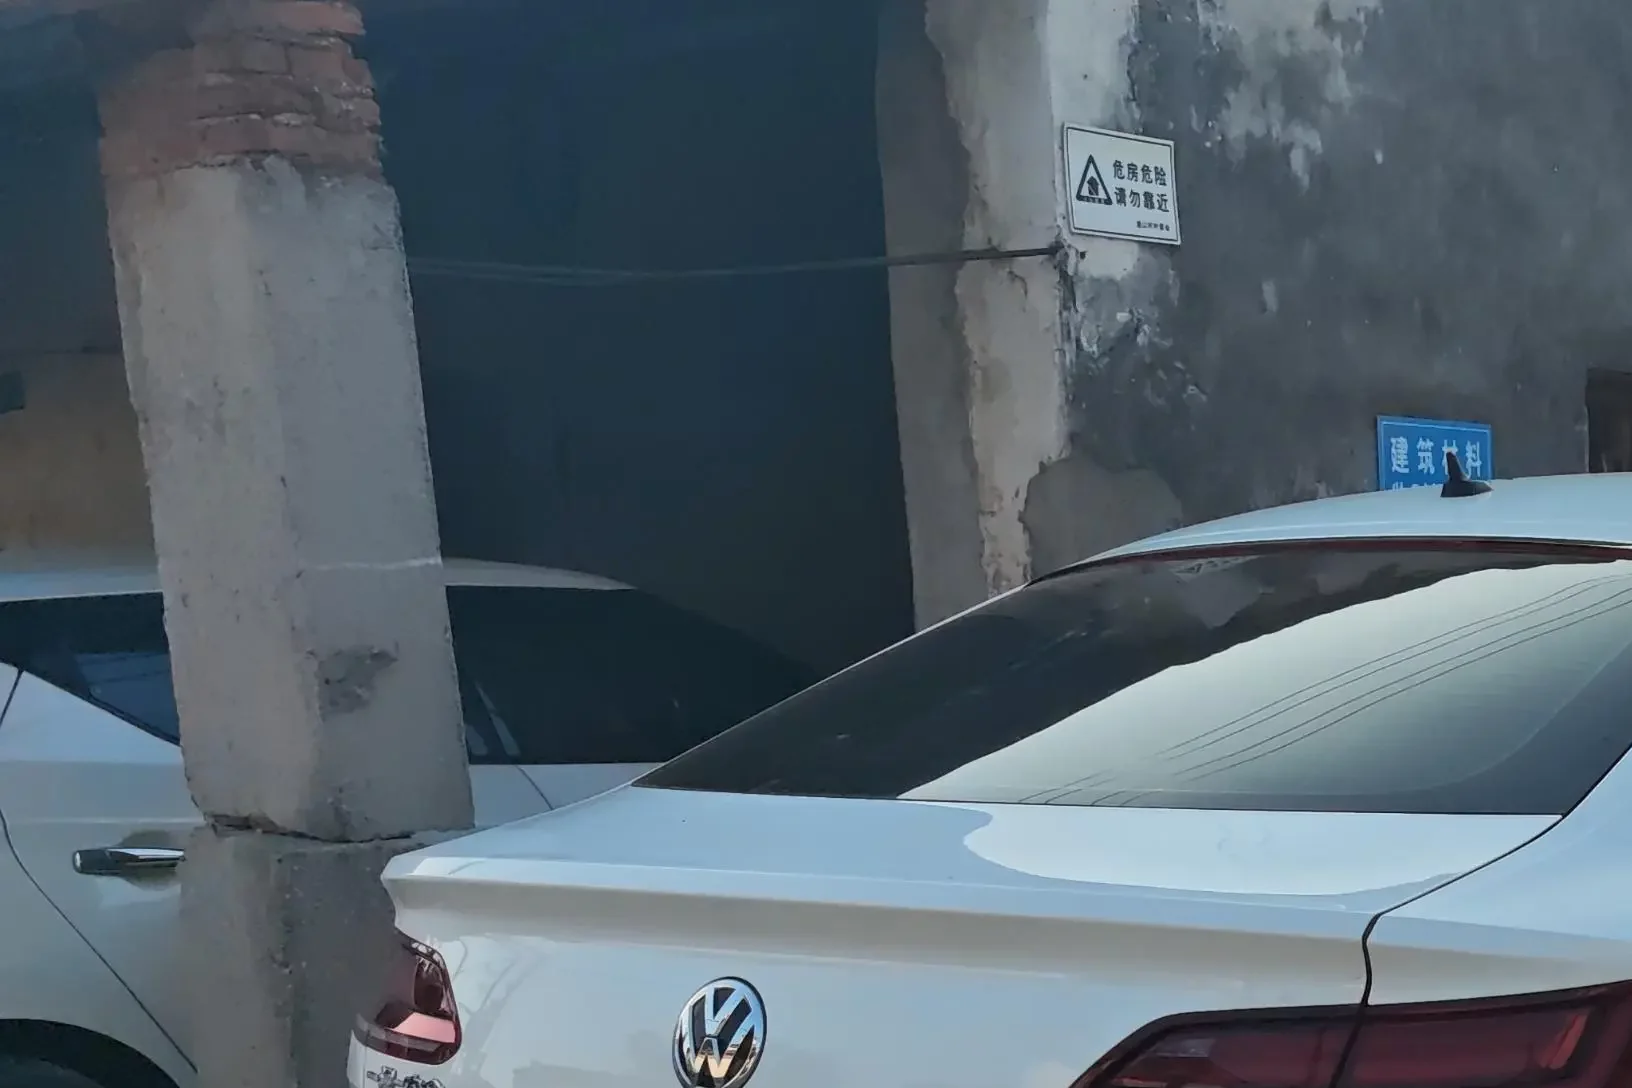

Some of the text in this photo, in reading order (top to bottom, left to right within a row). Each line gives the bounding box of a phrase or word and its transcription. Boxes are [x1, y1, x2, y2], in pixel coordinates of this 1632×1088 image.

[1112, 159, 1168, 187] 危房危险
[1113, 186, 1170, 213] 请勿靠近
